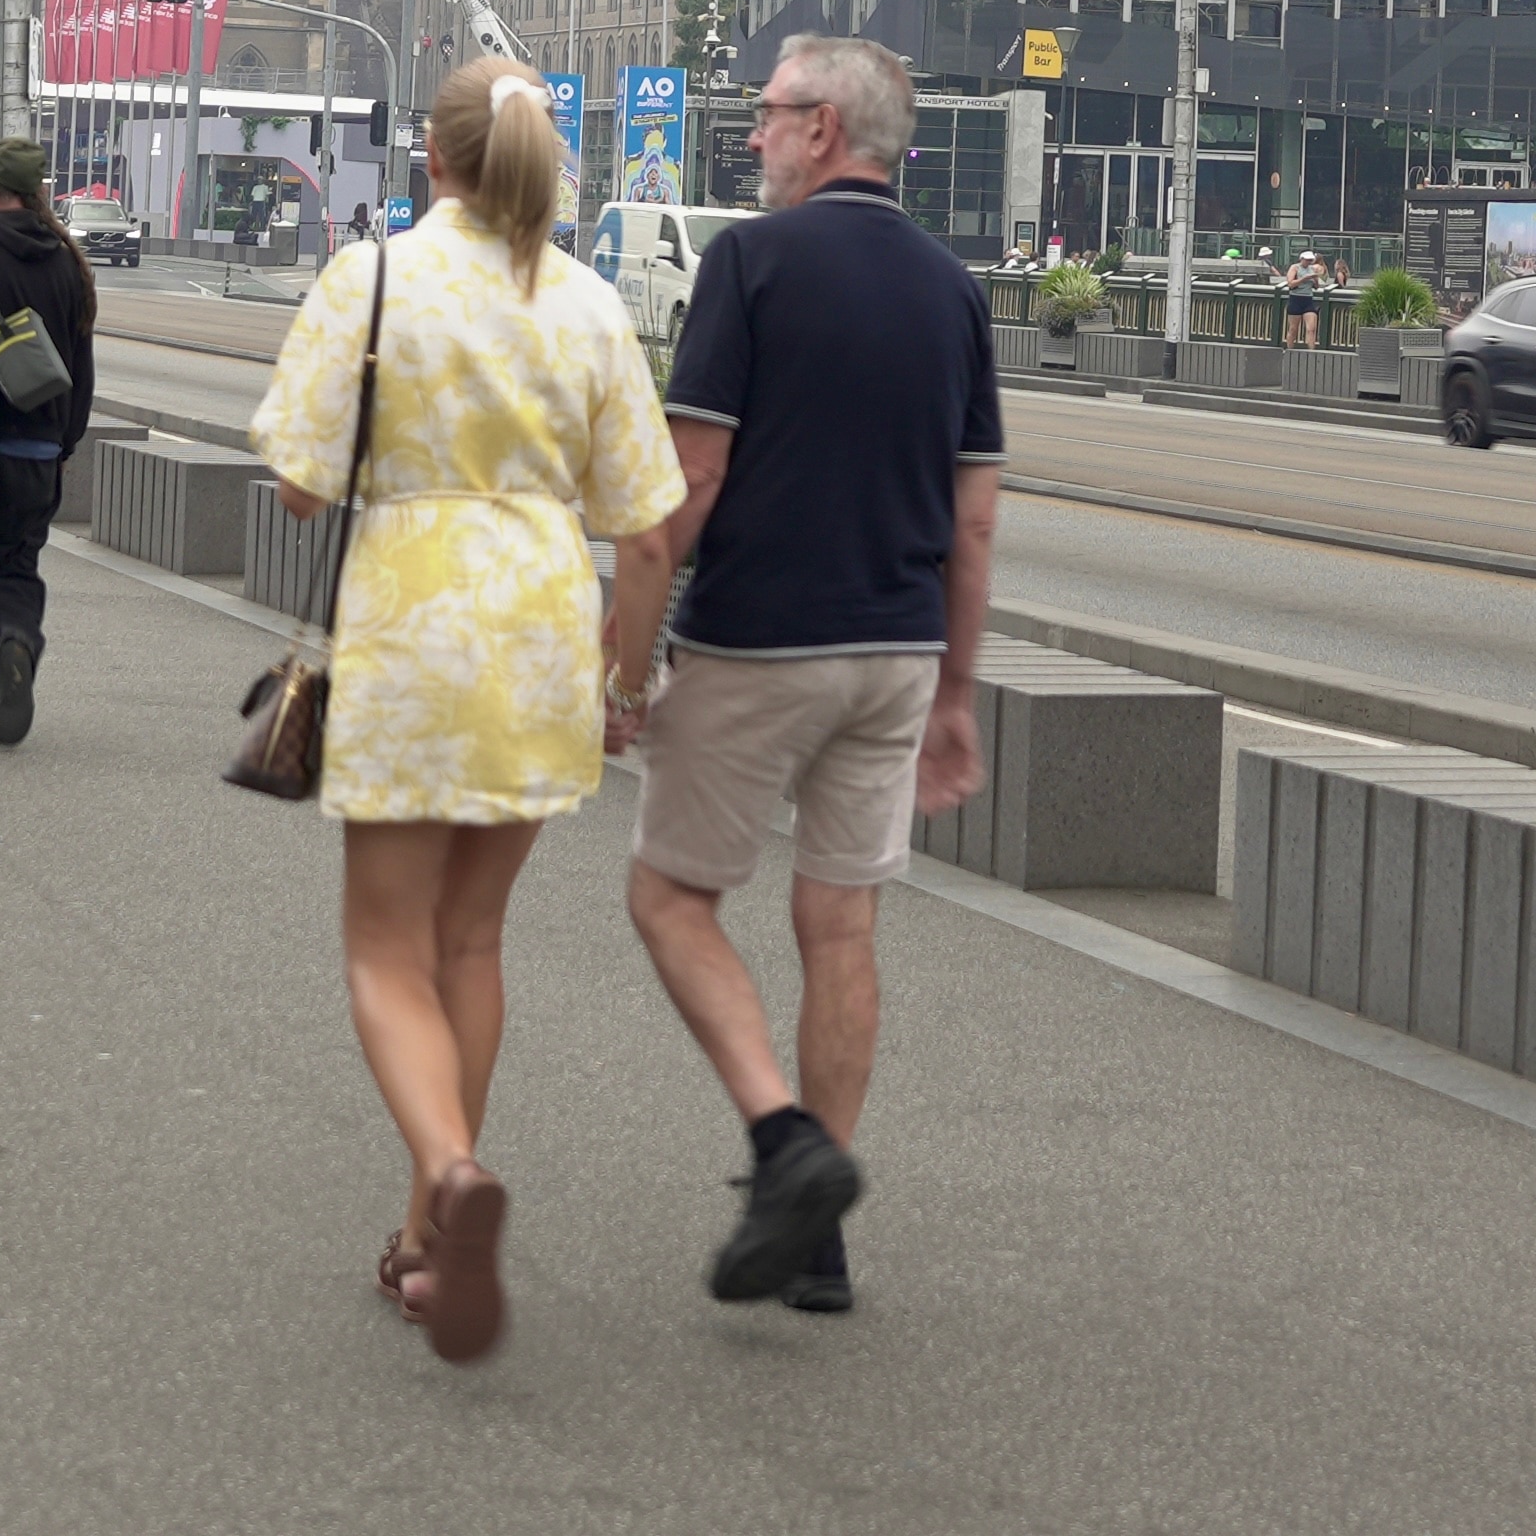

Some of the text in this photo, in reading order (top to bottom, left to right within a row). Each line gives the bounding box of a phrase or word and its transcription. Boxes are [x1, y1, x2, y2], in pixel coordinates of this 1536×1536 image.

[1028, 41, 1058, 54] Public
[1034, 56, 1052, 66] Bar
[636, 76, 675, 97] AO
[912, 95, 964, 105] RANSPORT
[389, 206, 411, 218] AO
